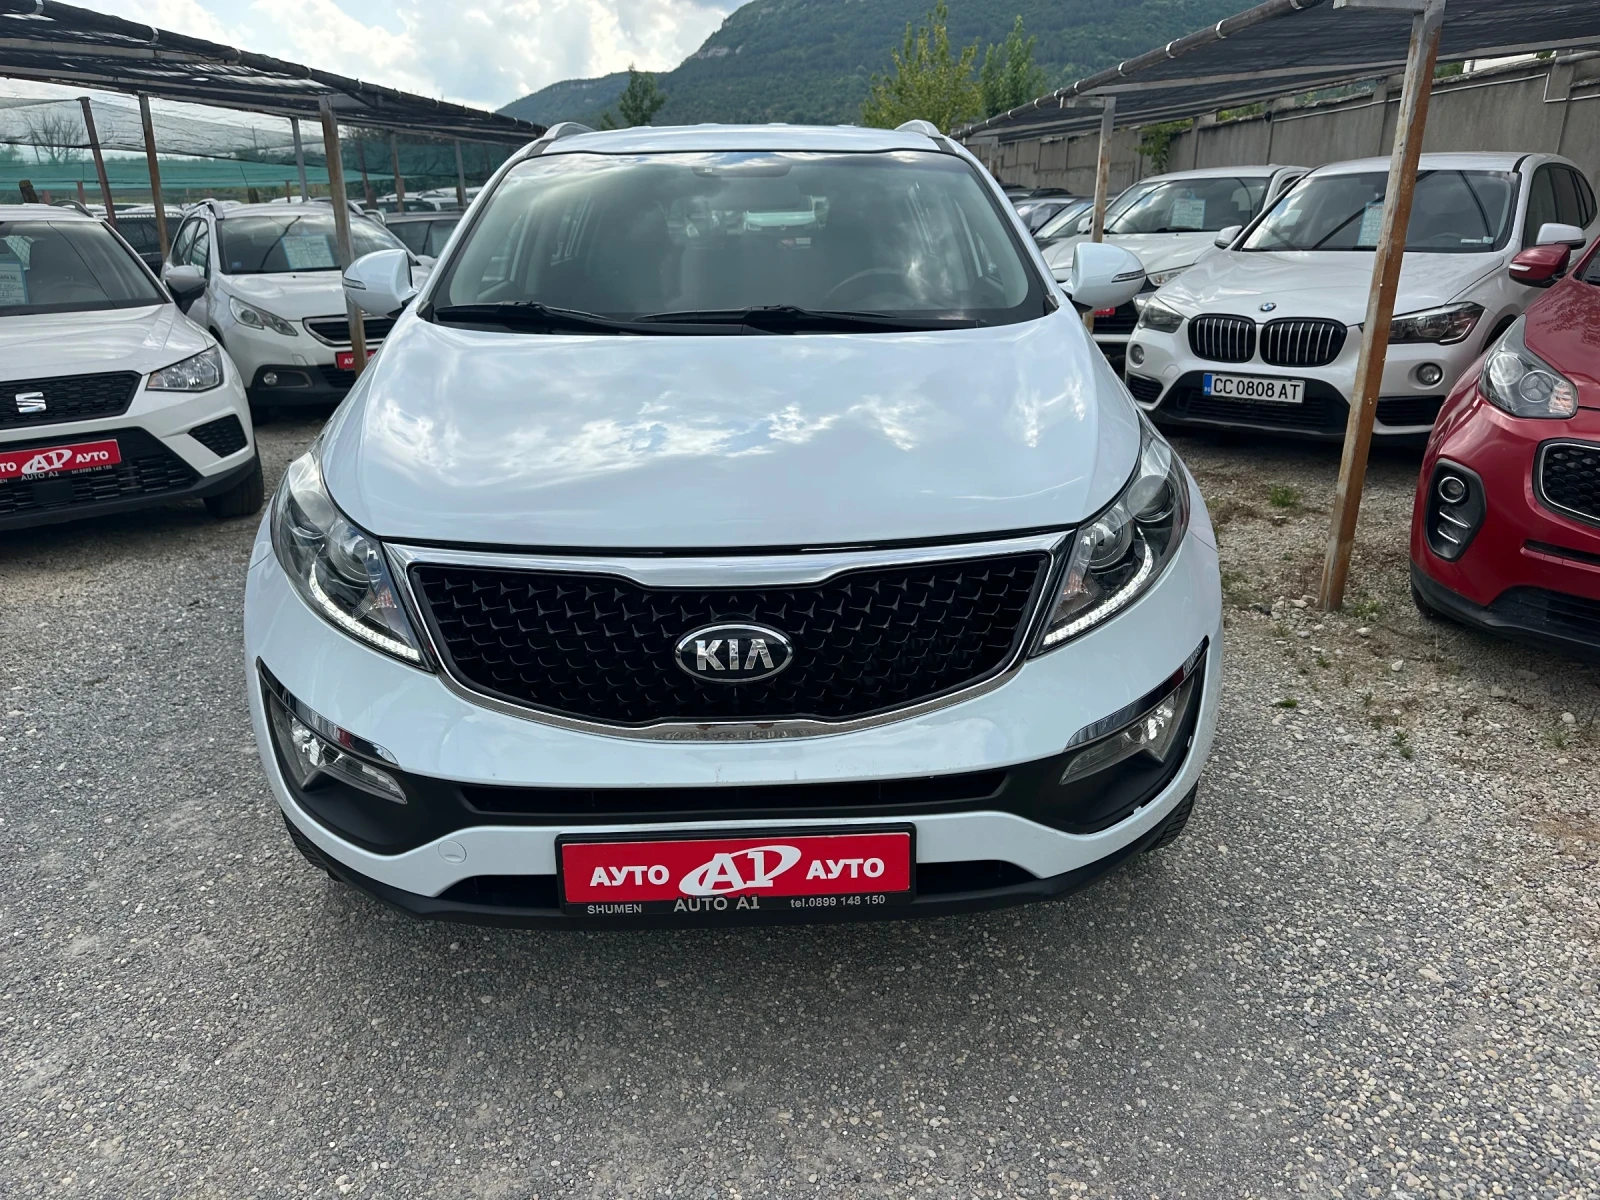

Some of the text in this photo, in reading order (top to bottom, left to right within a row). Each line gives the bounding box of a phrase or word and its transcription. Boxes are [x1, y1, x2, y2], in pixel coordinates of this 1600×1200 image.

[1213, 378, 1300, 400] CC 0808 AT
[0, 462, 17, 473] ТО
[76, 451, 109, 464] АУТО
[21, 470, 59, 481] AUTO A1
[695, 638, 775, 671] KIA
[589, 848, 885, 893] АУТО A1 АУТО
[587, 904, 643, 915] SHUMEN
[673, 895, 761, 913] AUTO A1
[790, 894, 886, 908] tel.0899 148 150
